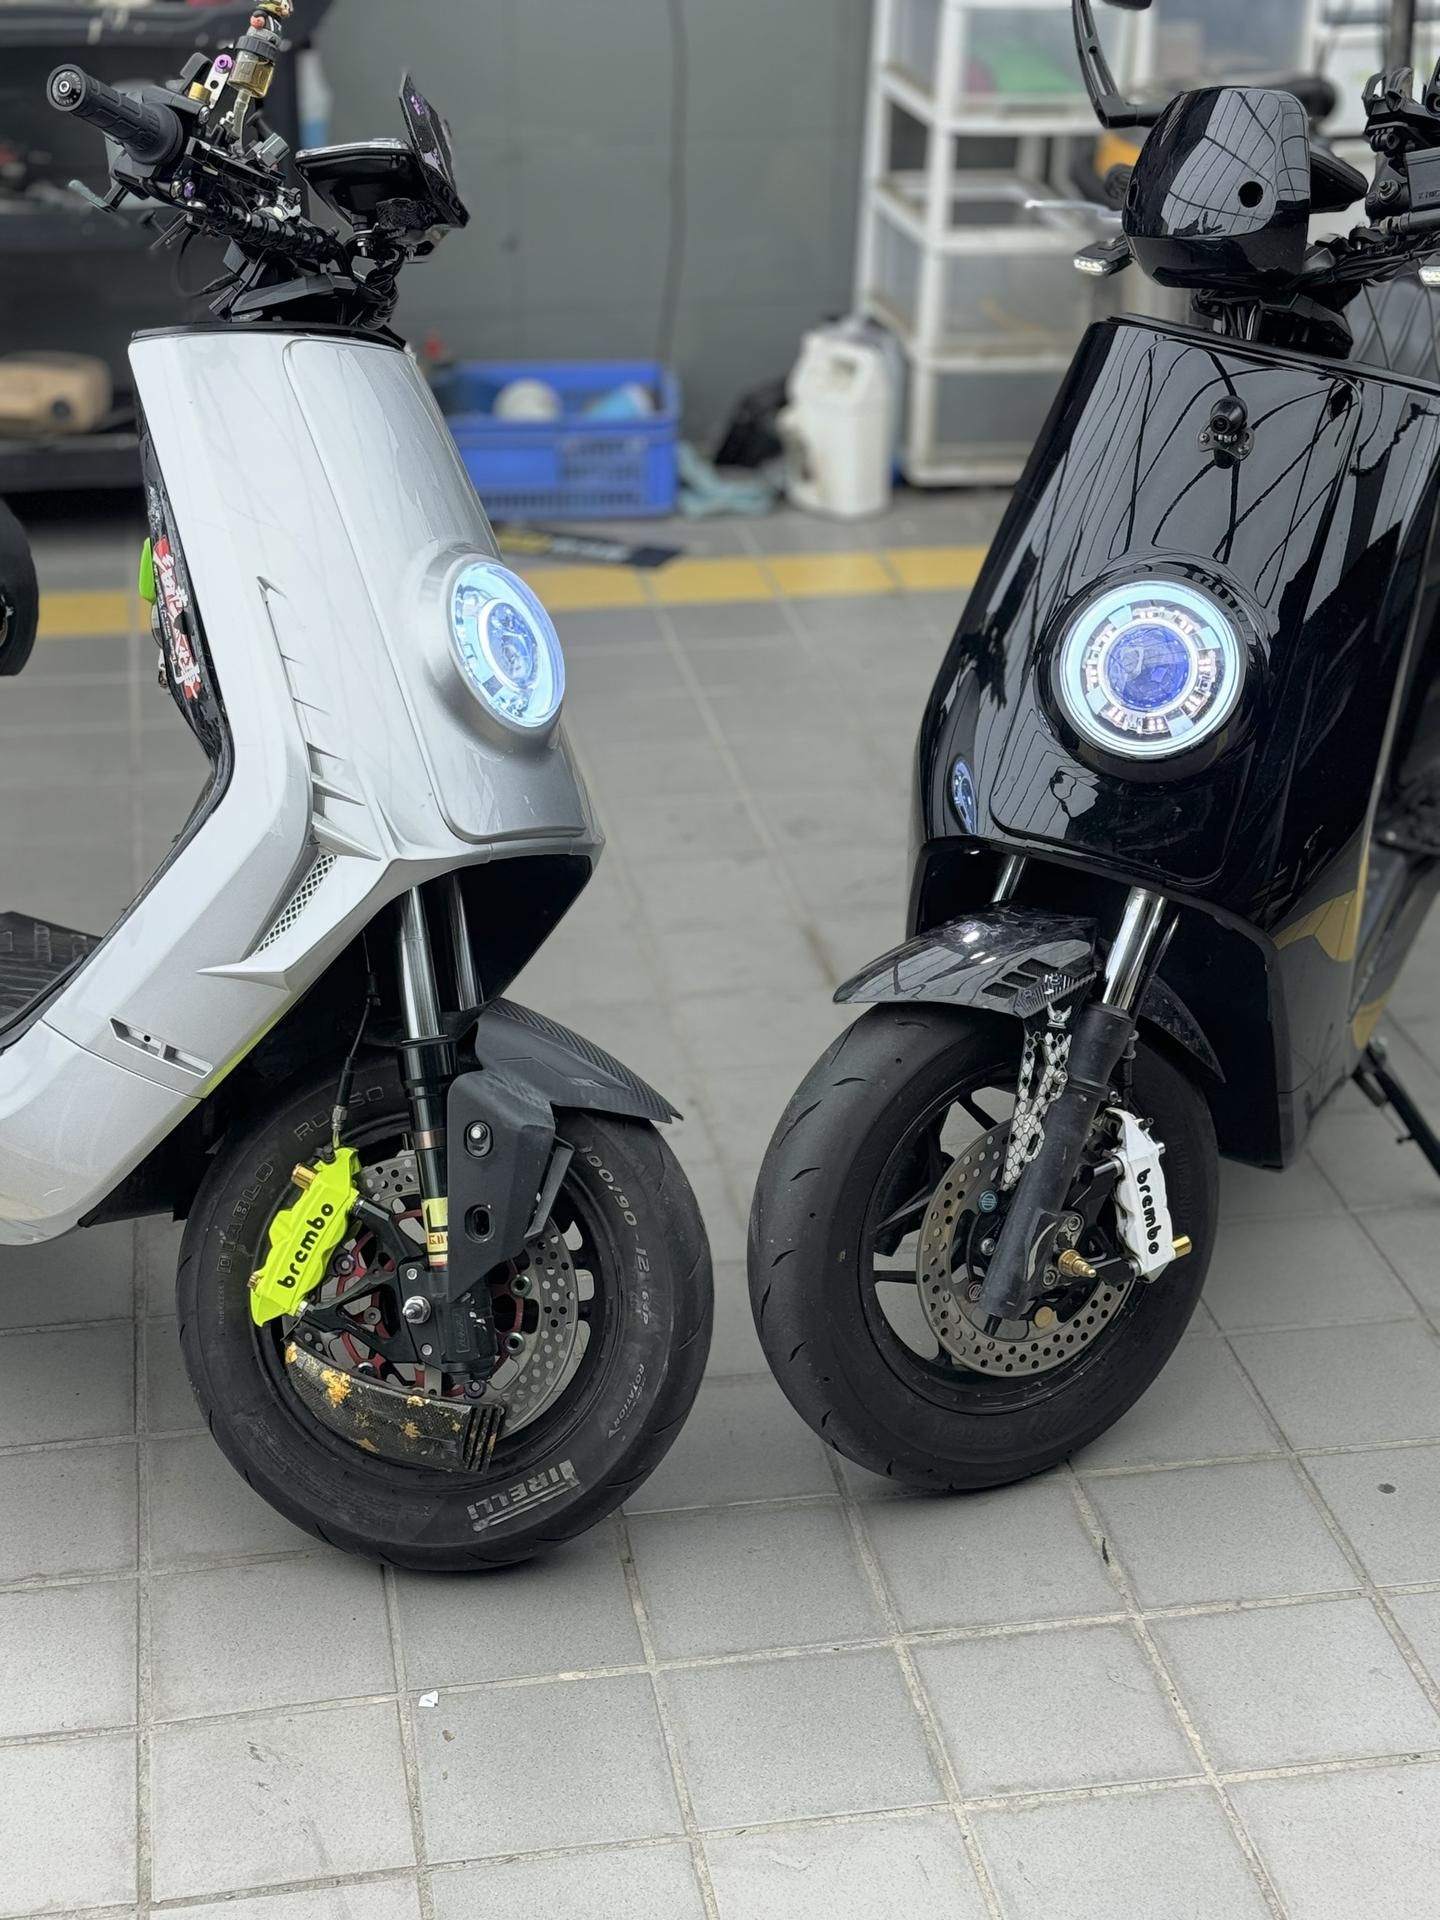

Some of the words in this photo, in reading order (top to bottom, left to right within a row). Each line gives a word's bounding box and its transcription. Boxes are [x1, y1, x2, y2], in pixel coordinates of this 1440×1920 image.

[216, 1161, 274, 1274] DIABLO
[293, 1085, 385, 1142] ROSO
[1136, 1167, 1162, 1255] brembo
[276, 1202, 335, 1290] brembo
[465, 1458, 582, 1532] PIRELLI
